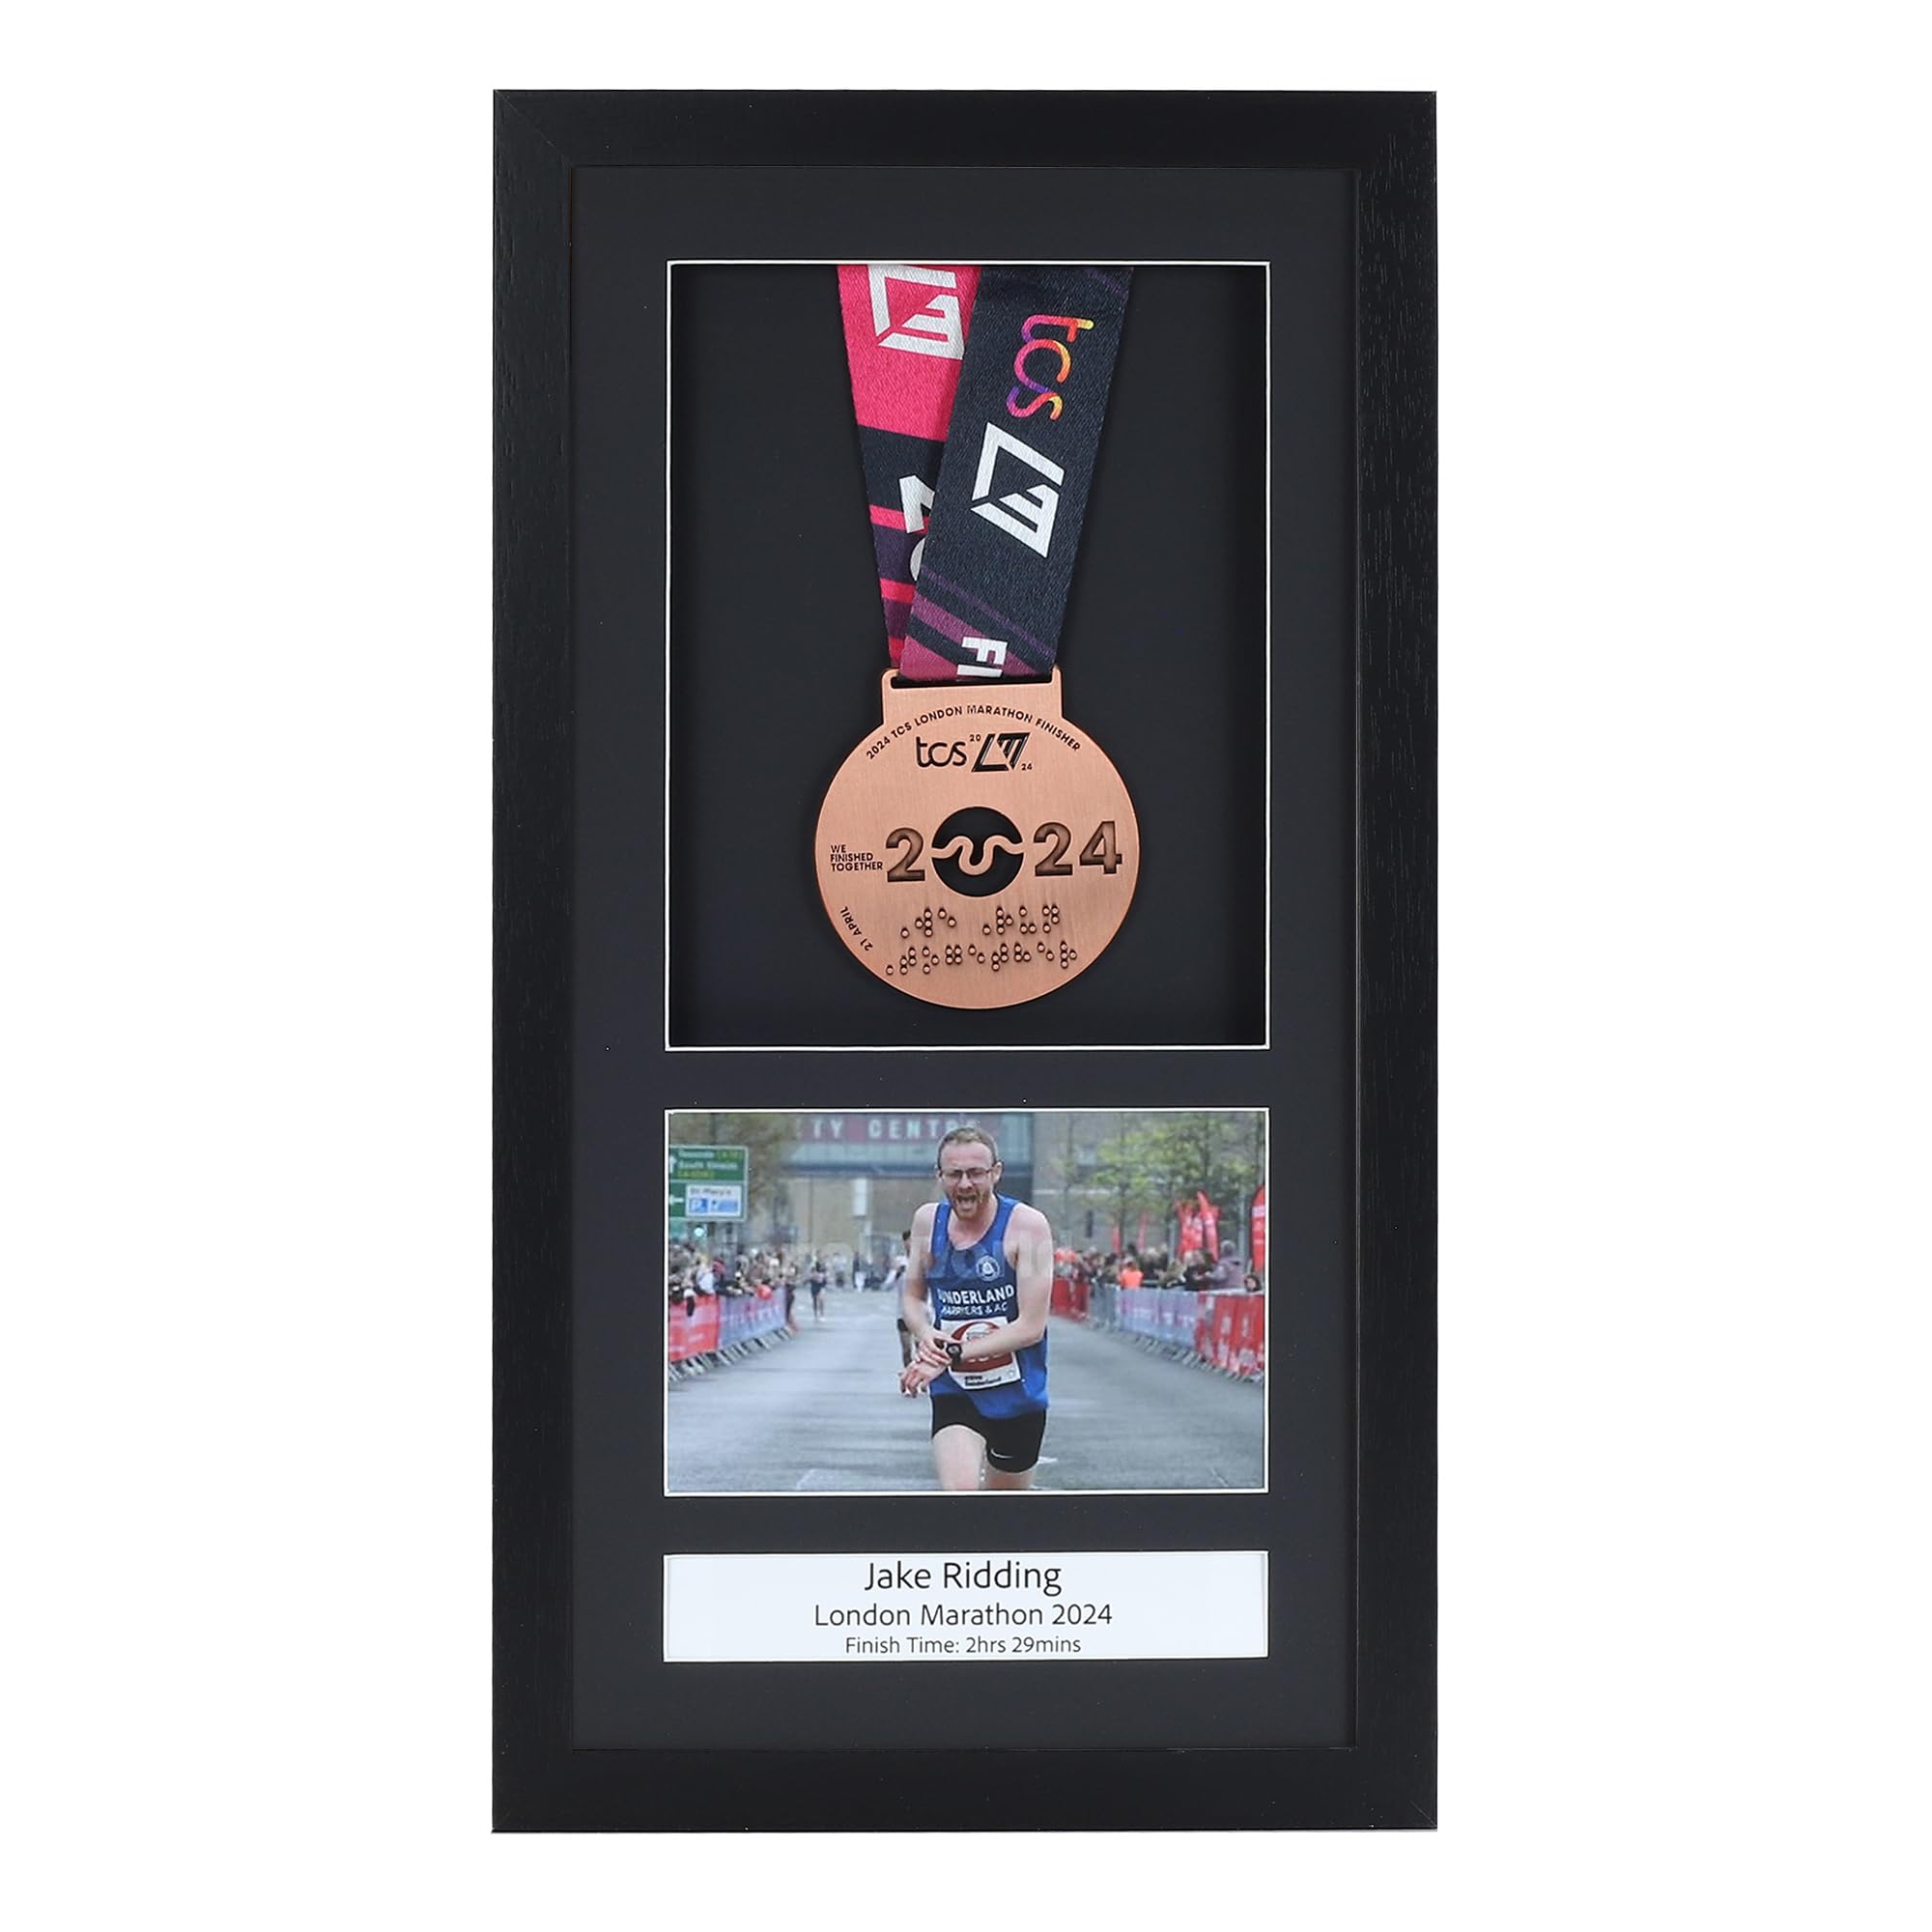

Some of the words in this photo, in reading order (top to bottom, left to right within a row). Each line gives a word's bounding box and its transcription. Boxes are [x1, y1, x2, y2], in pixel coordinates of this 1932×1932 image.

[1006, 314, 1094, 420] tcs
[866, 736, 891, 759] 2024
[891, 722, 913, 738] TCS
[914, 705, 963, 726] LONDON
[967, 705, 1034, 724] MARATHON
[1035, 718, 1081, 752] FINISHER
[916, 736, 968, 768] tcs
[830, 853, 873, 863] FINISHED
[831, 844, 846, 853] WE
[831, 862, 883, 872] TOGETHER
[839, 906, 862, 936] APRIL
[860, 938, 873, 952] 21
[867, 1119, 974, 1139] CENTR
[937, 1284, 1014, 1305] UNDERLAND
[865, 1561, 931, 1590] Jake
[944, 1560, 1063, 1597] Ridding
[814, 1604, 911, 1627] London
[921, 1603, 1044, 1627] Marathon
[1052, 1604, 1113, 1626] 2024
[844, 1635, 900, 1654] Finish
[906, 1635, 959, 1654] Time:
[966, 1635, 1007, 1654] 2hrs
[1011, 1635, 1082, 1655] 29mins
